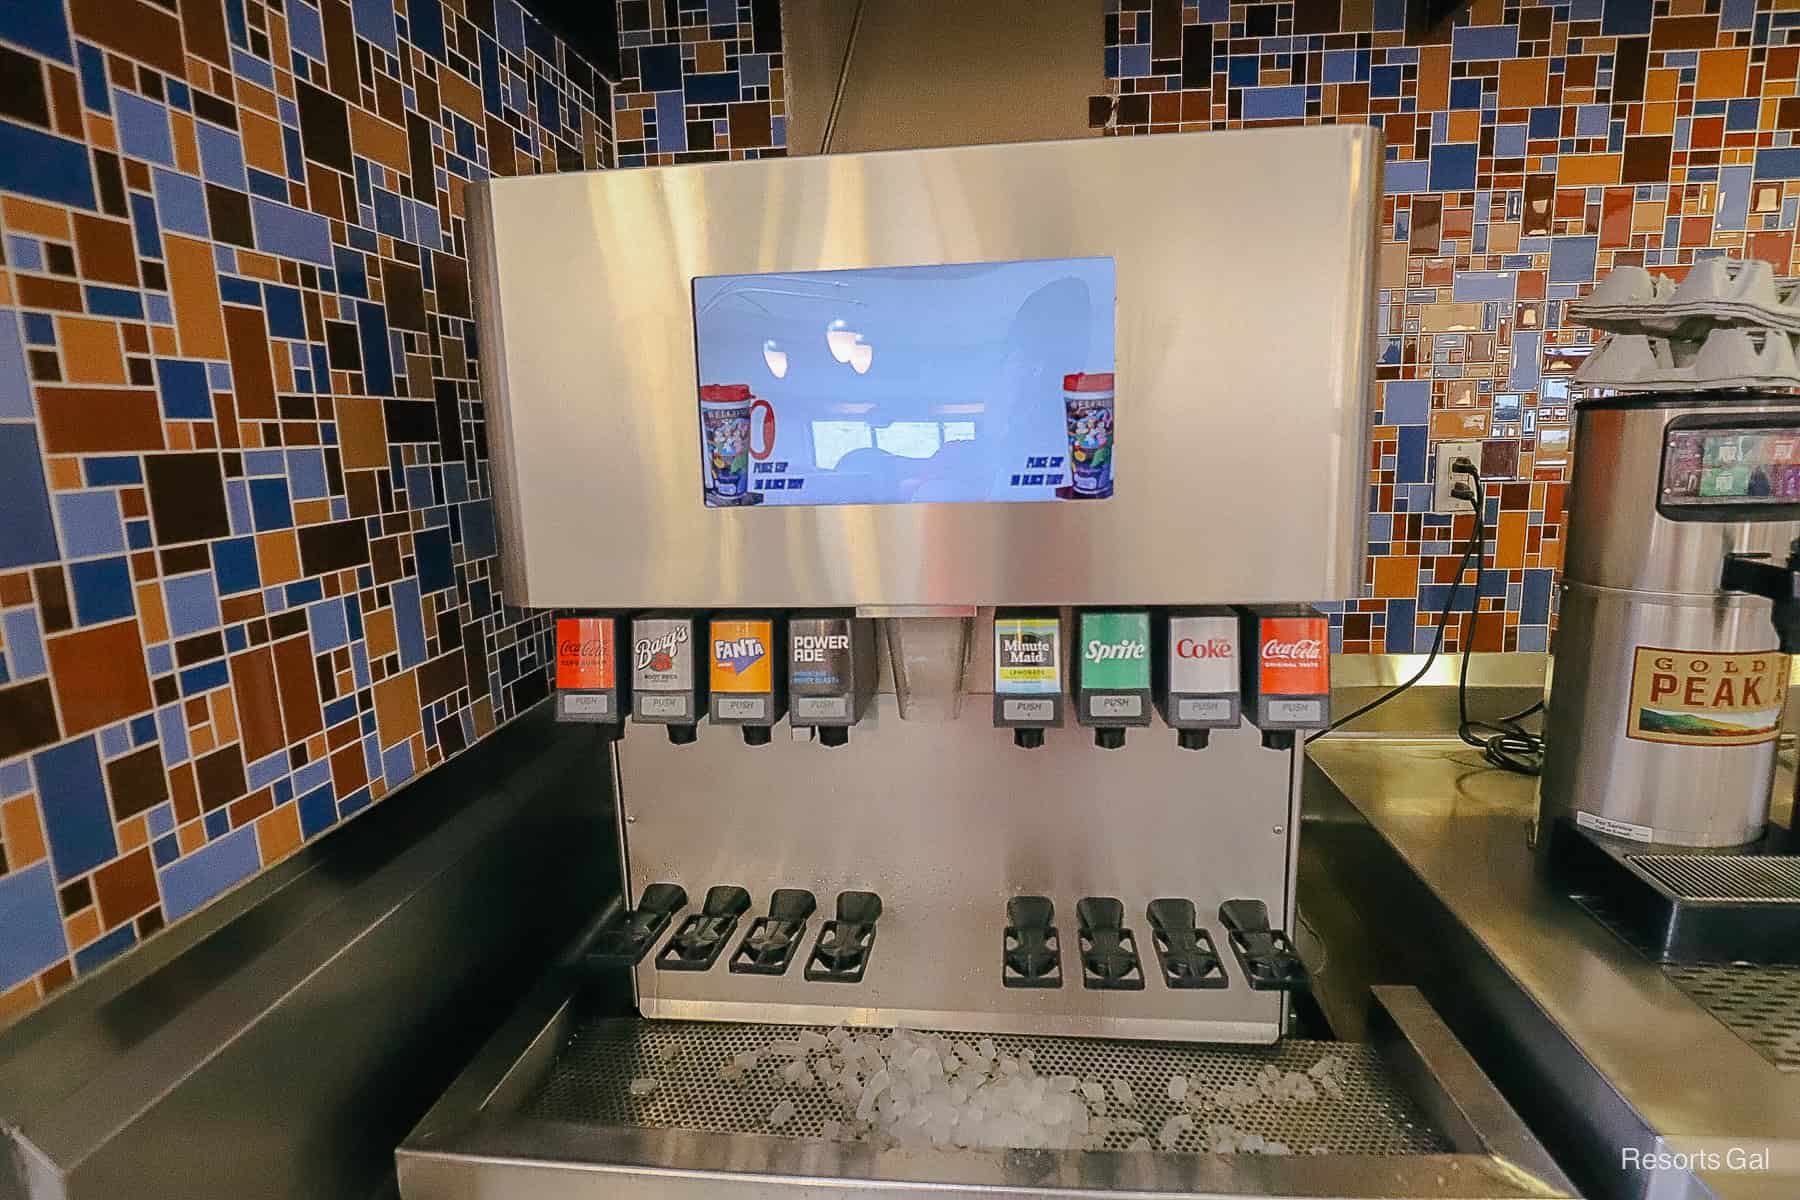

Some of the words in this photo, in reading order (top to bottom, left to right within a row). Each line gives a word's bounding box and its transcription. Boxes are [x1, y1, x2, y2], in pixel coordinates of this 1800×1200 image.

[635, 624, 688, 671] Barq's
[714, 637, 765, 660] FANTA
[793, 636, 849, 649] POWER
[1004, 639, 1050, 652] Minute
[1176, 638, 1232, 659] Coke
[793, 649, 825, 662] ADE
[1010, 650, 1044, 663] Maid
[1085, 639, 1145, 664] Sprite
[1653, 656, 1769, 673] GOLD
[1649, 673, 1764, 707] PEAK
[575, 696, 597, 705] PUSH
[730, 701, 754, 710] PUSH
[1016, 702, 1042, 712] PUSH
[1103, 697, 1129, 707] PUSH
[1192, 702, 1219, 712] PUSH
[1282, 703, 1308, 713] PUSH
